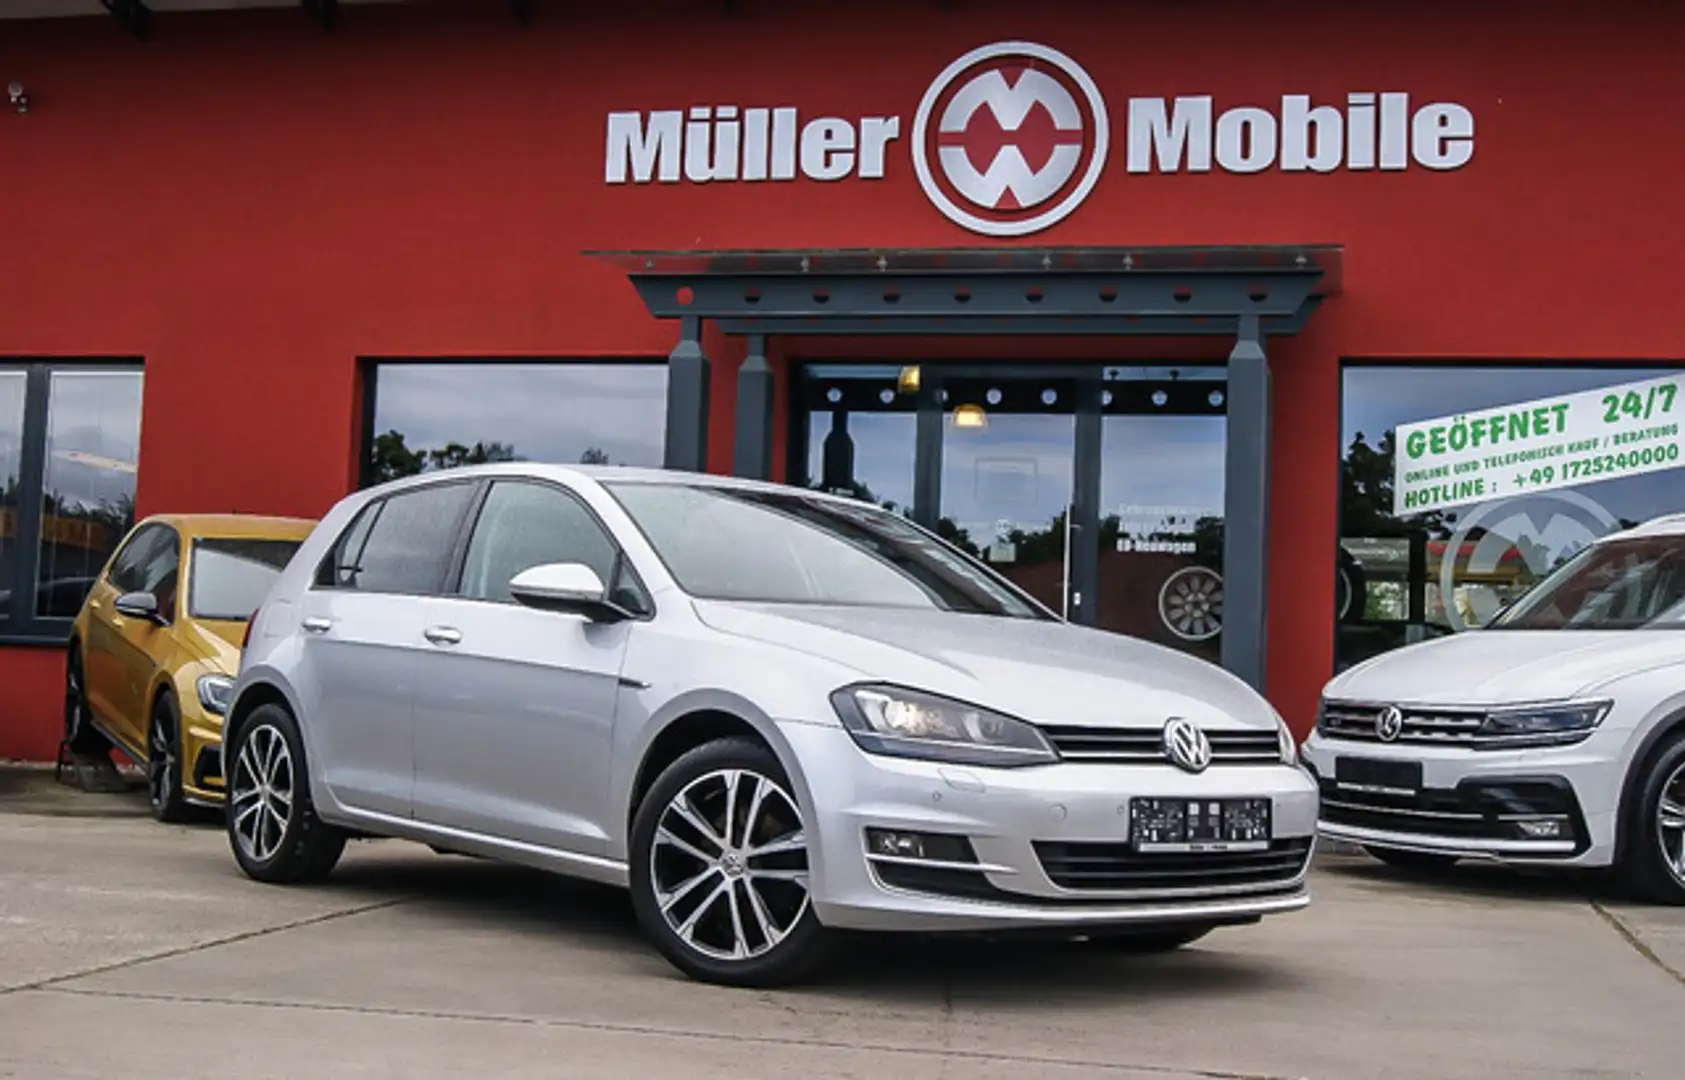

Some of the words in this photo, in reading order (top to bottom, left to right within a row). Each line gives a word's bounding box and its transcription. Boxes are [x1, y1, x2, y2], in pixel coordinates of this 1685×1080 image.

[605, 105, 900, 184] Müller
[1126, 91, 1474, 173] Mobile
[1404, 463, 1450, 484] ONLINE
[1453, 459, 1481, 475] UND
[1483, 444, 1565, 470] TELEFONISCH
[1566, 436, 1600, 454] KAUF
[1613, 423, 1679, 447] BERATUNG
[1405, 402, 1570, 460] GEÖFFNET
[1601, 381, 1678, 423] 24/7
[1404, 477, 1485, 509] HOTLINE
[1512, 465, 1555, 489] +49
[1561, 441, 1679, 482] 1725240000
